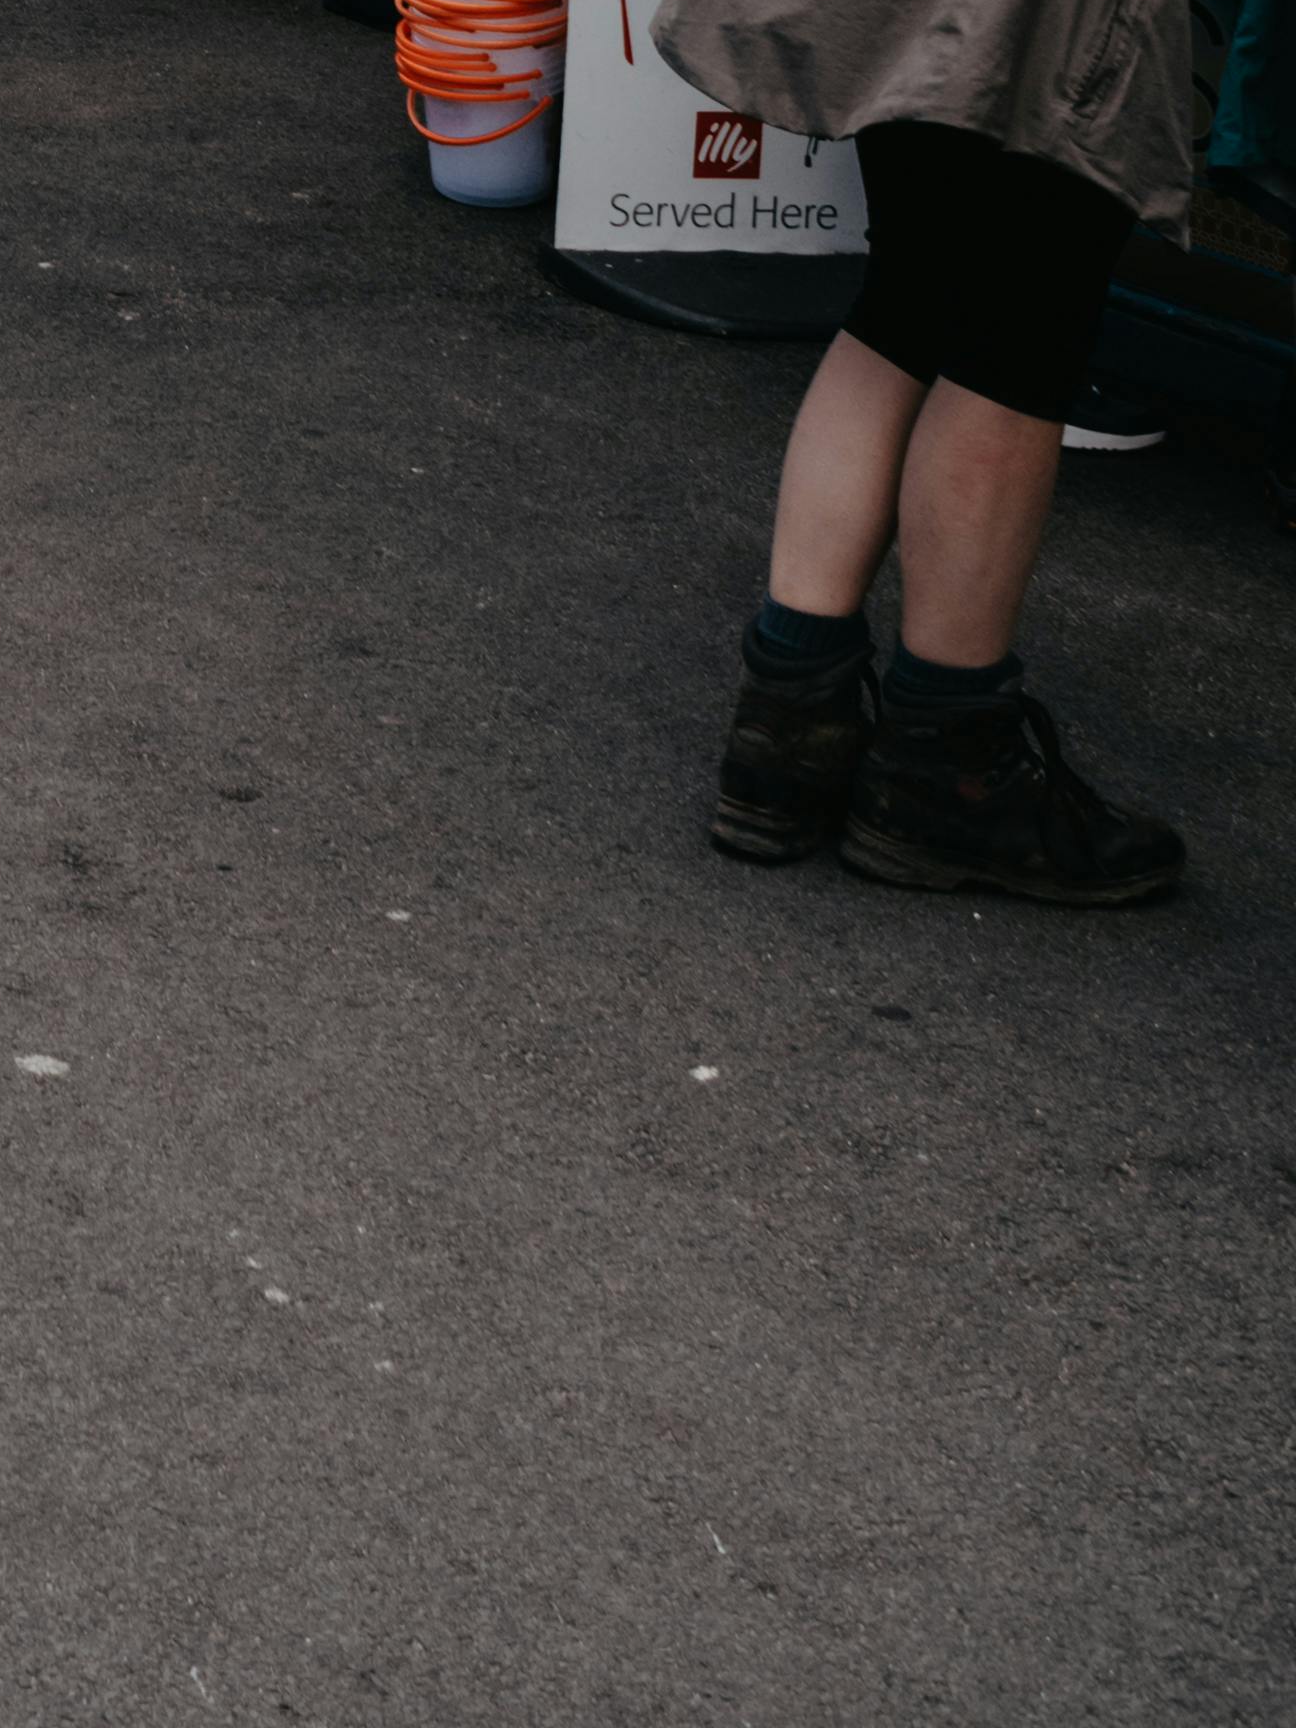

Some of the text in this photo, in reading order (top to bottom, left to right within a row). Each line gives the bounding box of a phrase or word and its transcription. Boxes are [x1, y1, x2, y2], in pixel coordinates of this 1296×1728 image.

[698, 121, 758, 173] illy
[609, 192, 838, 230] Served Here
